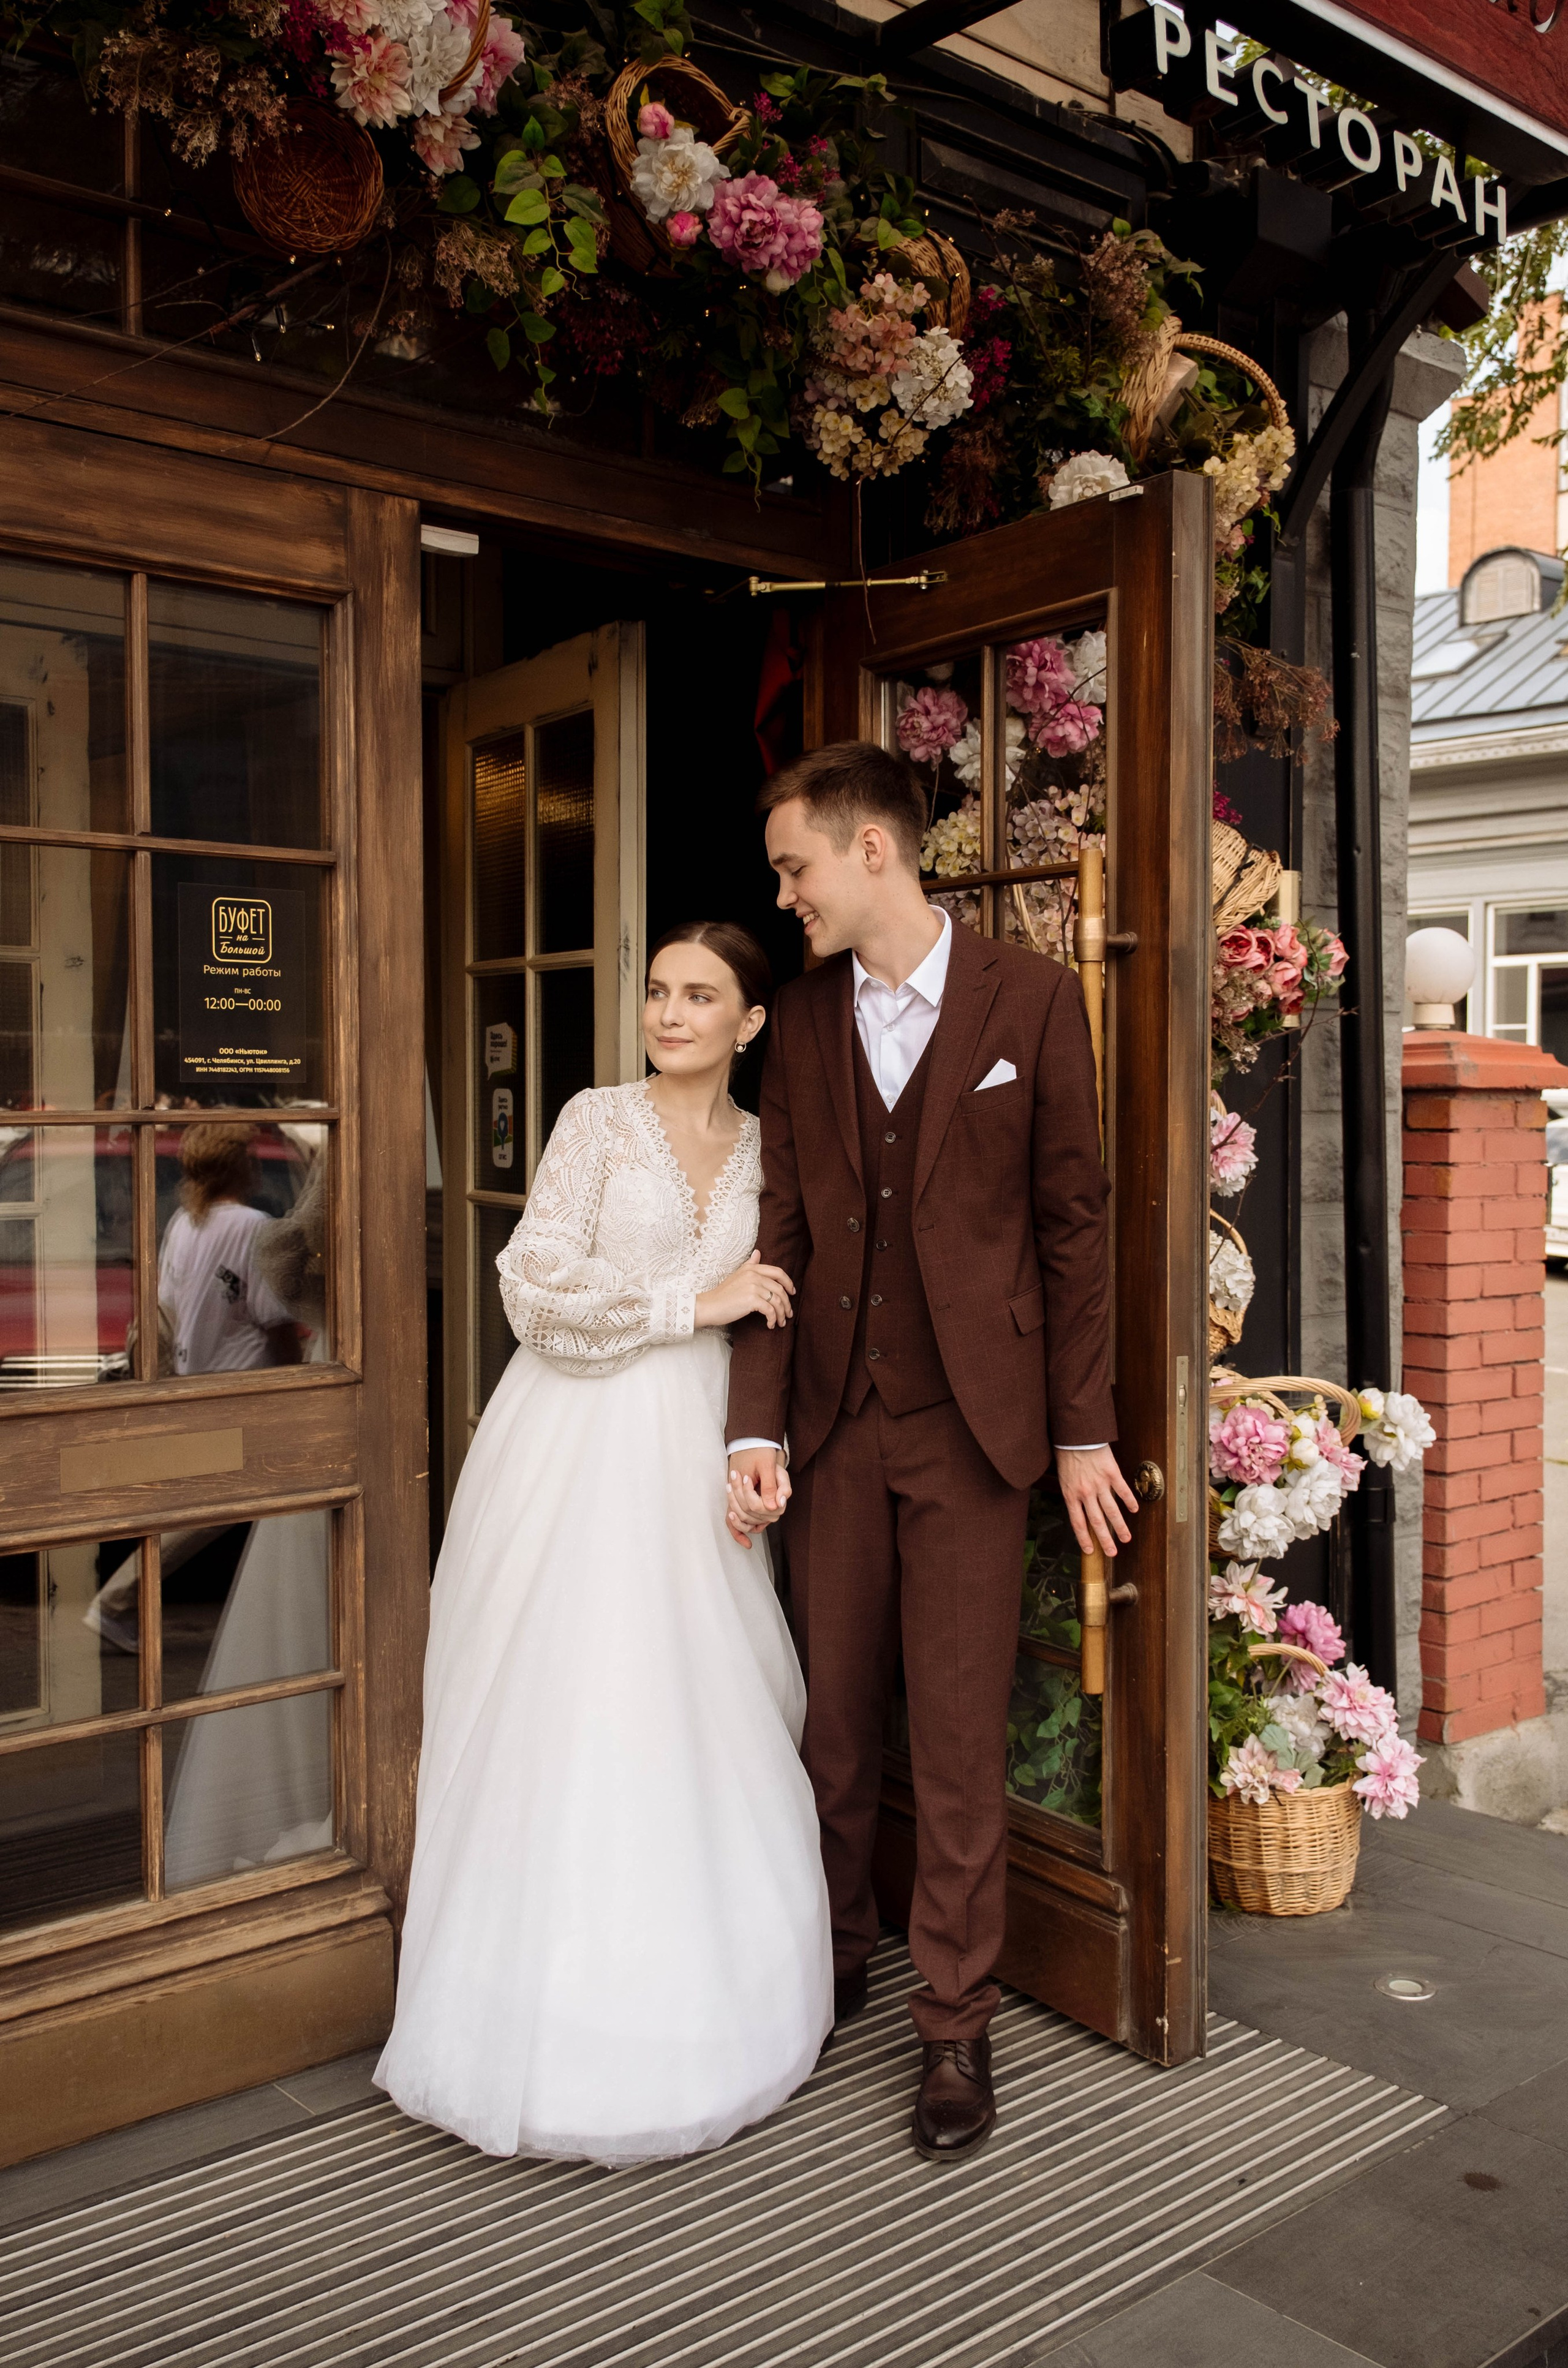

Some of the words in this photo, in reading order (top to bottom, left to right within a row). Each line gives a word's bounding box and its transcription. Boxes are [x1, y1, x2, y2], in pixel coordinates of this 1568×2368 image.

[1154, 2, 1507, 245] РЕСТОРАН
[219, 907, 265, 934] БУФЕТ
[221, 941, 266, 955] Большой
[203, 965, 239, 975] Режим
[243, 967, 281, 978] работы
